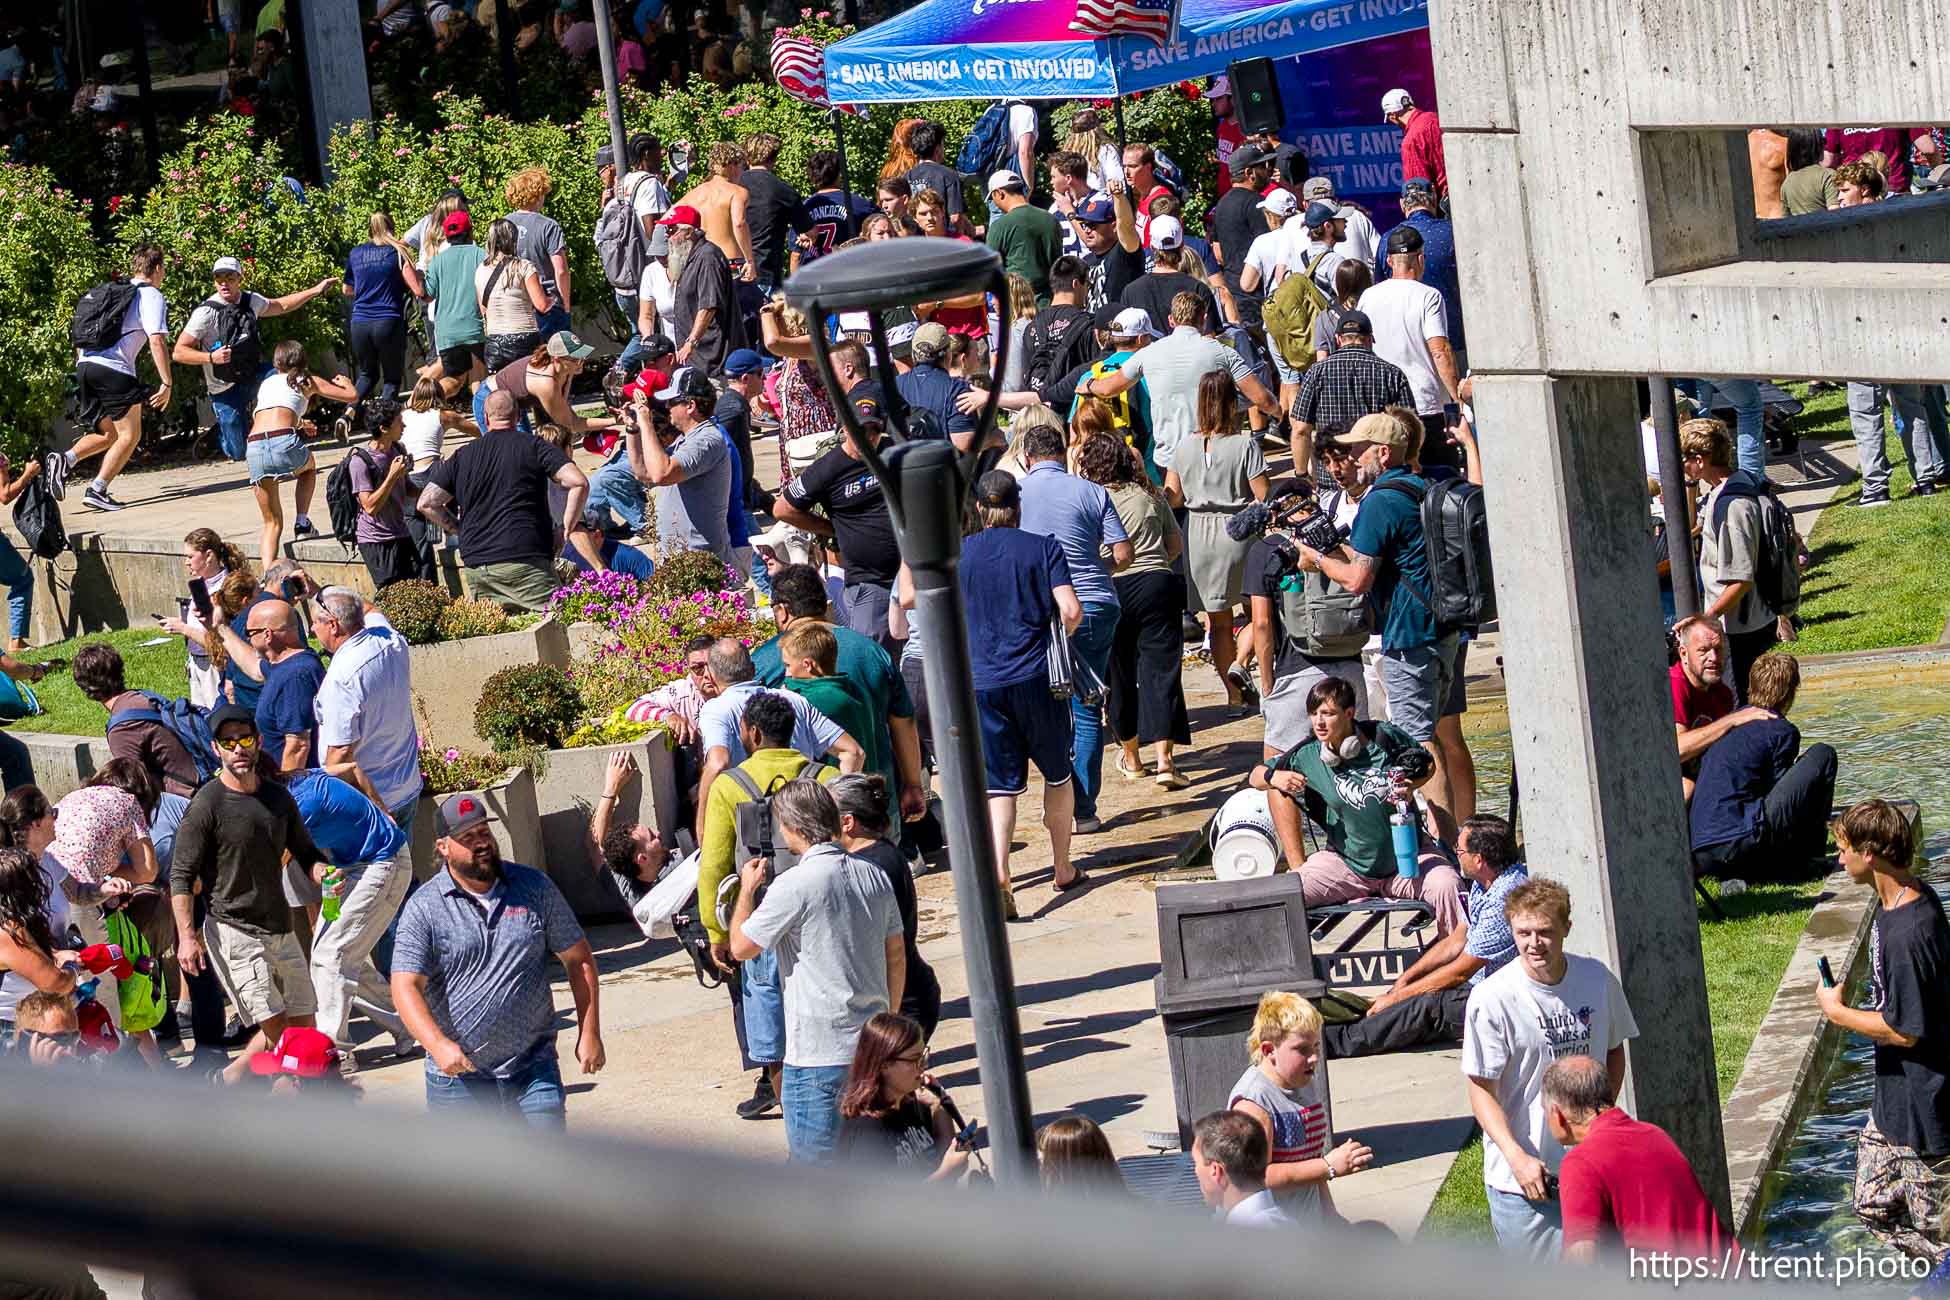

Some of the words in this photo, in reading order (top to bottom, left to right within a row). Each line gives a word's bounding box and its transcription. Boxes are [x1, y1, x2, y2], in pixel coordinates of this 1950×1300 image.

[1130, 40, 1189, 71] SAVE
[1194, 20, 1294, 57] AMERICA
[1308, 5, 1355, 32] GET
[841, 63, 885, 84] SAVE
[888, 60, 962, 81] AMERICA
[973, 61, 1006, 81] GET
[1010, 58, 1096, 80] INVOLVED
[1296, 132, 1356, 158] SAVE
[816, 223, 837, 255] 7
[845, 481, 861, 498] US
[1581, 1024, 1592, 1040] of
